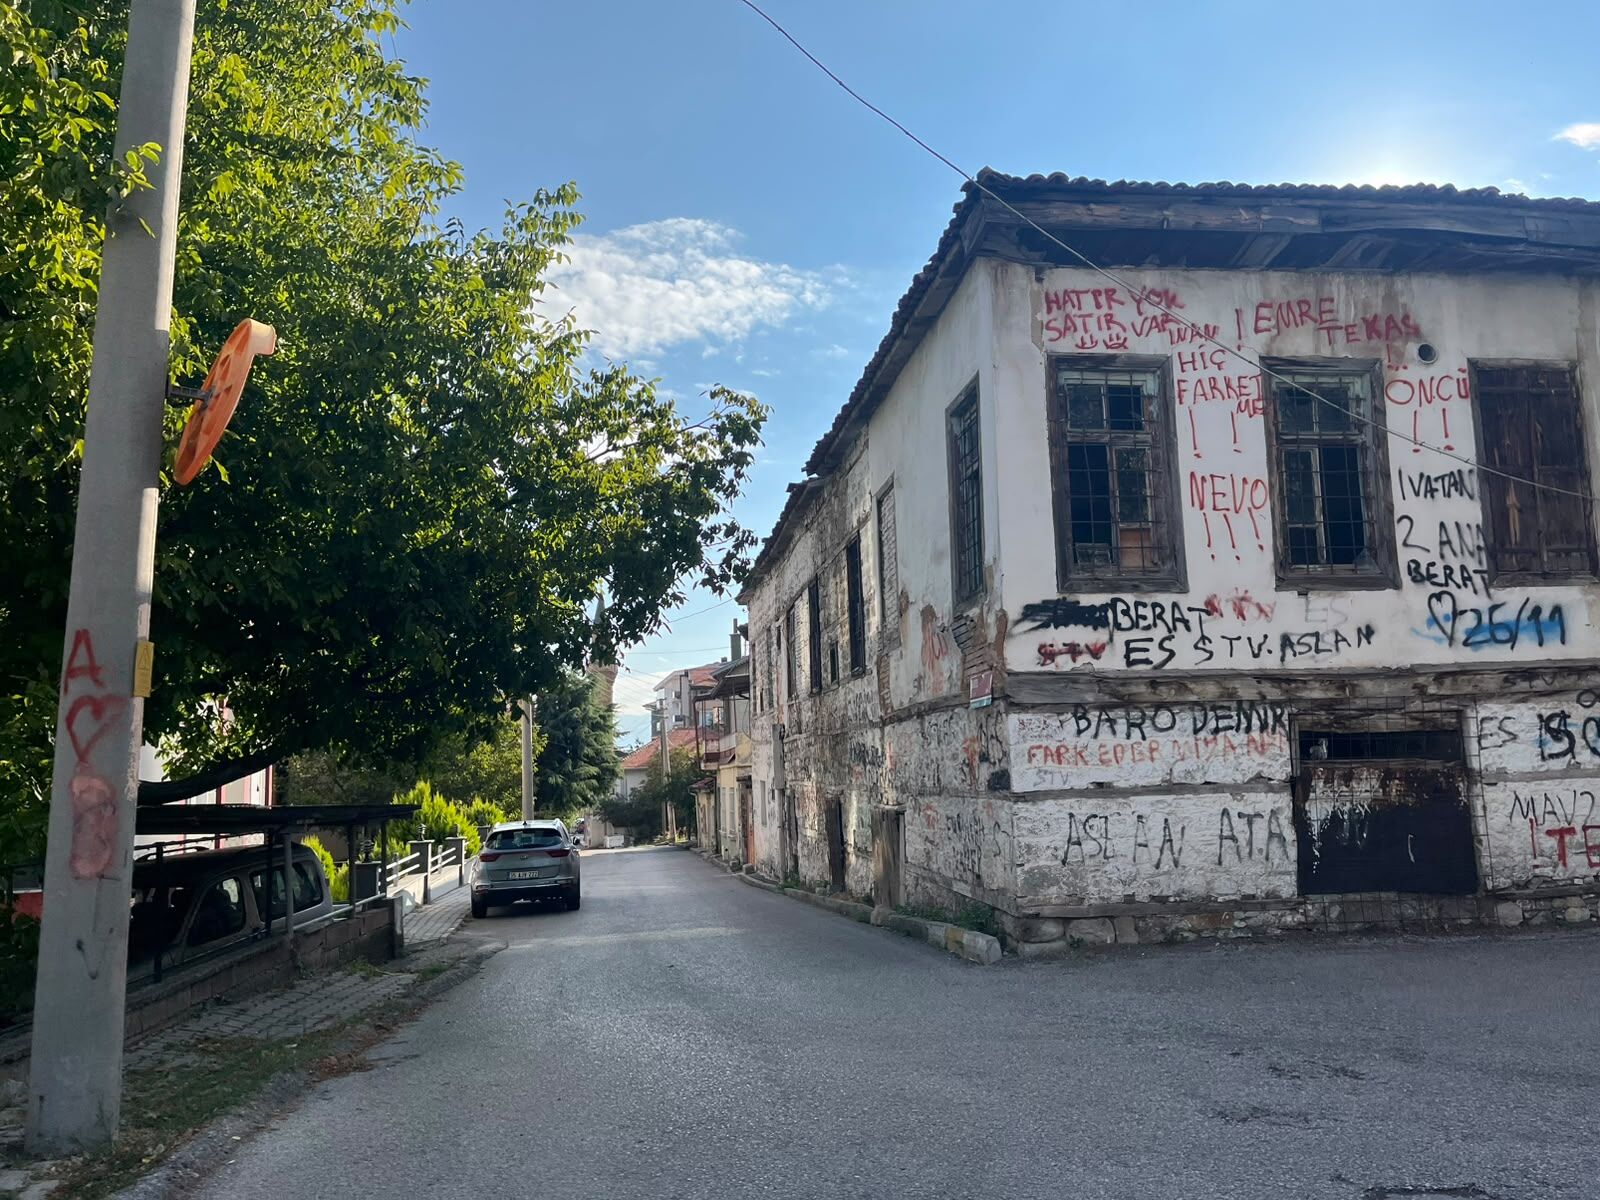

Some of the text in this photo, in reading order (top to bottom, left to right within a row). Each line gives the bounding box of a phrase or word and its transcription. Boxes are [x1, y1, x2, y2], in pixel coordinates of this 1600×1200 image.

[1045, 312, 1127, 342] SATIR
[1253, 297, 1339, 336] EMRE
[1189, 471, 1268, 514] NEVO
[1408, 468, 1475, 501] VATAN
[1396, 514, 1431, 553] 2
[1407, 559, 1493, 600] BERAT
[1110, 597, 1213, 645] BERAT
[64, 628, 105, 695] A
[1124, 634, 1177, 670] ES
[1280, 624, 1376, 666] ASLAN
[1479, 715, 1518, 750] ES
